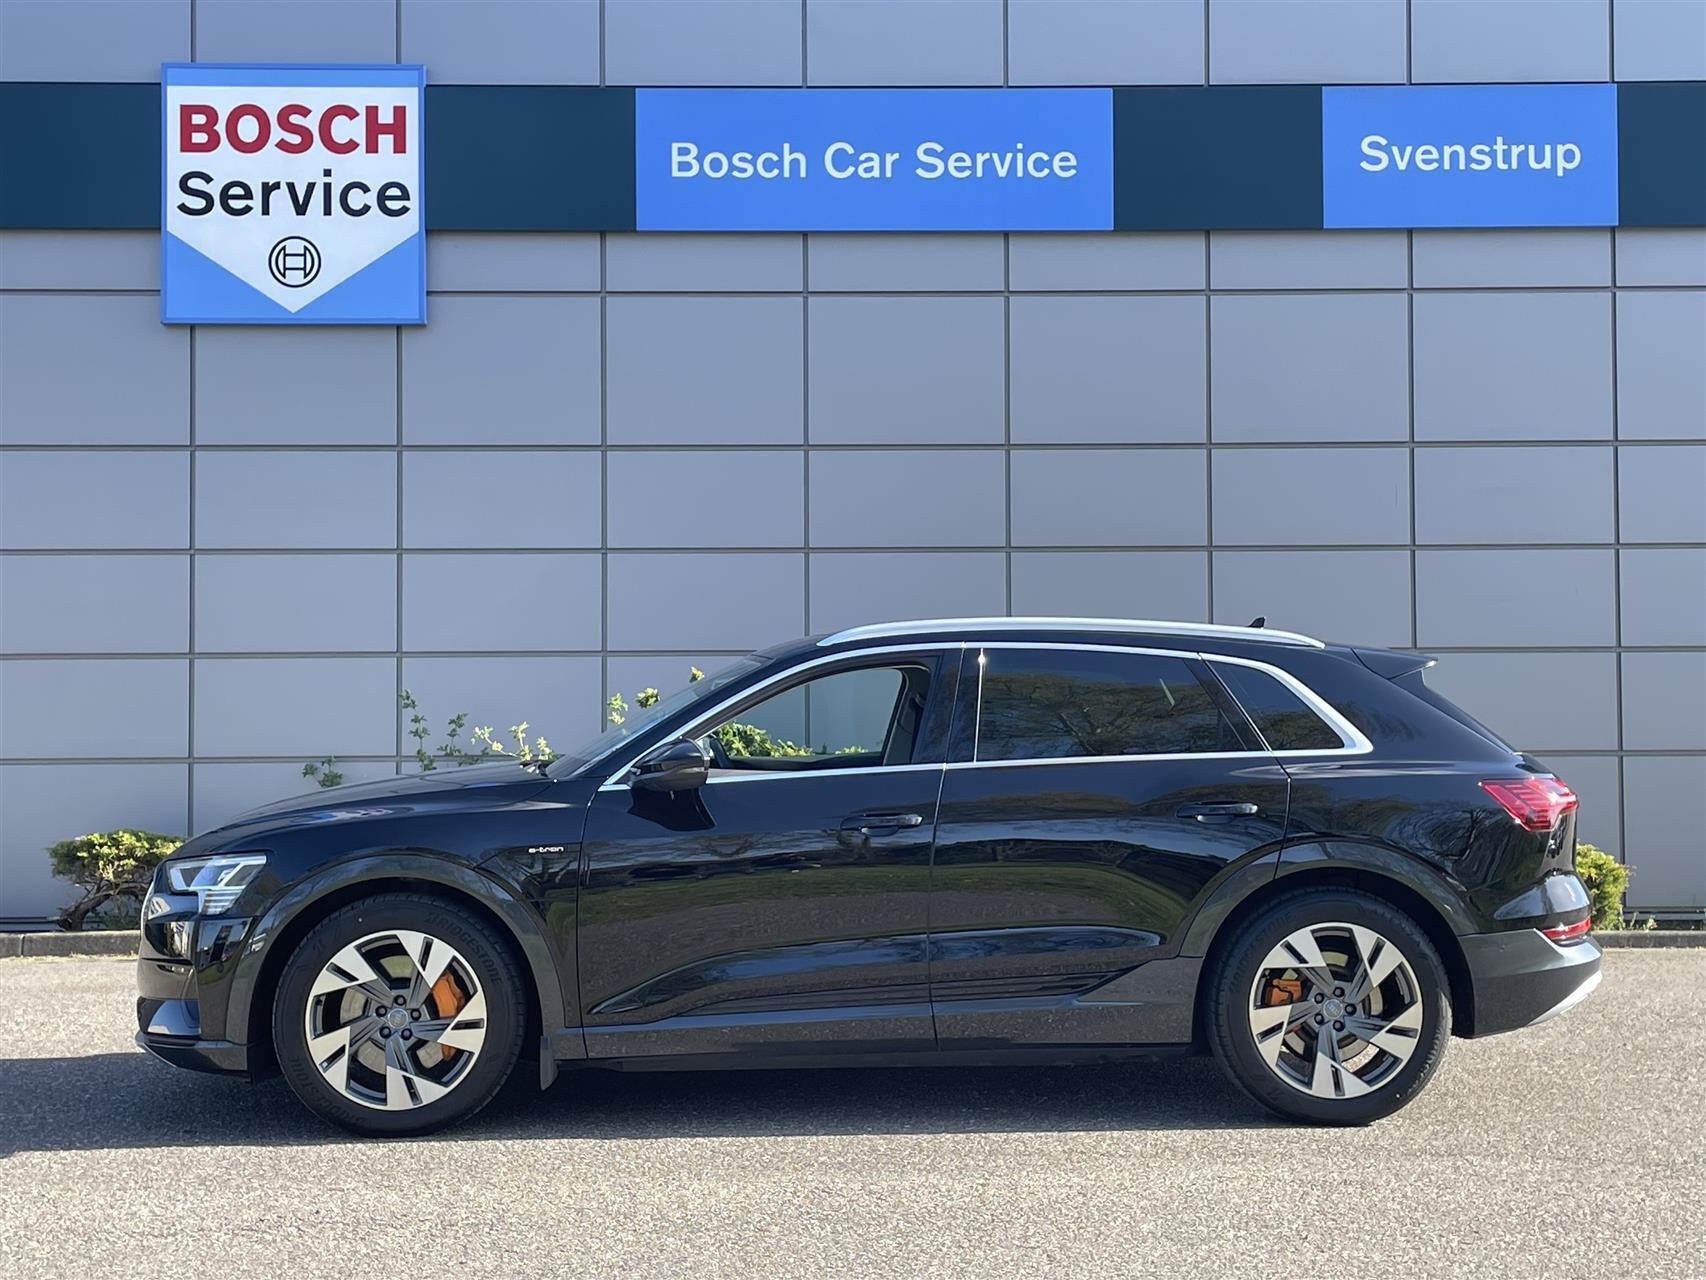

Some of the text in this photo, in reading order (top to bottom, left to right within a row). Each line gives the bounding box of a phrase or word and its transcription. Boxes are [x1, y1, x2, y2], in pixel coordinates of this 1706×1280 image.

[179, 103, 407, 154] BOSCH
[670, 142, 1077, 179] Bosch Car Service
[1359, 135, 1582, 177] Svenstrup
[177, 168, 411, 218] Service
[528, 846, 564, 854] e-tron
